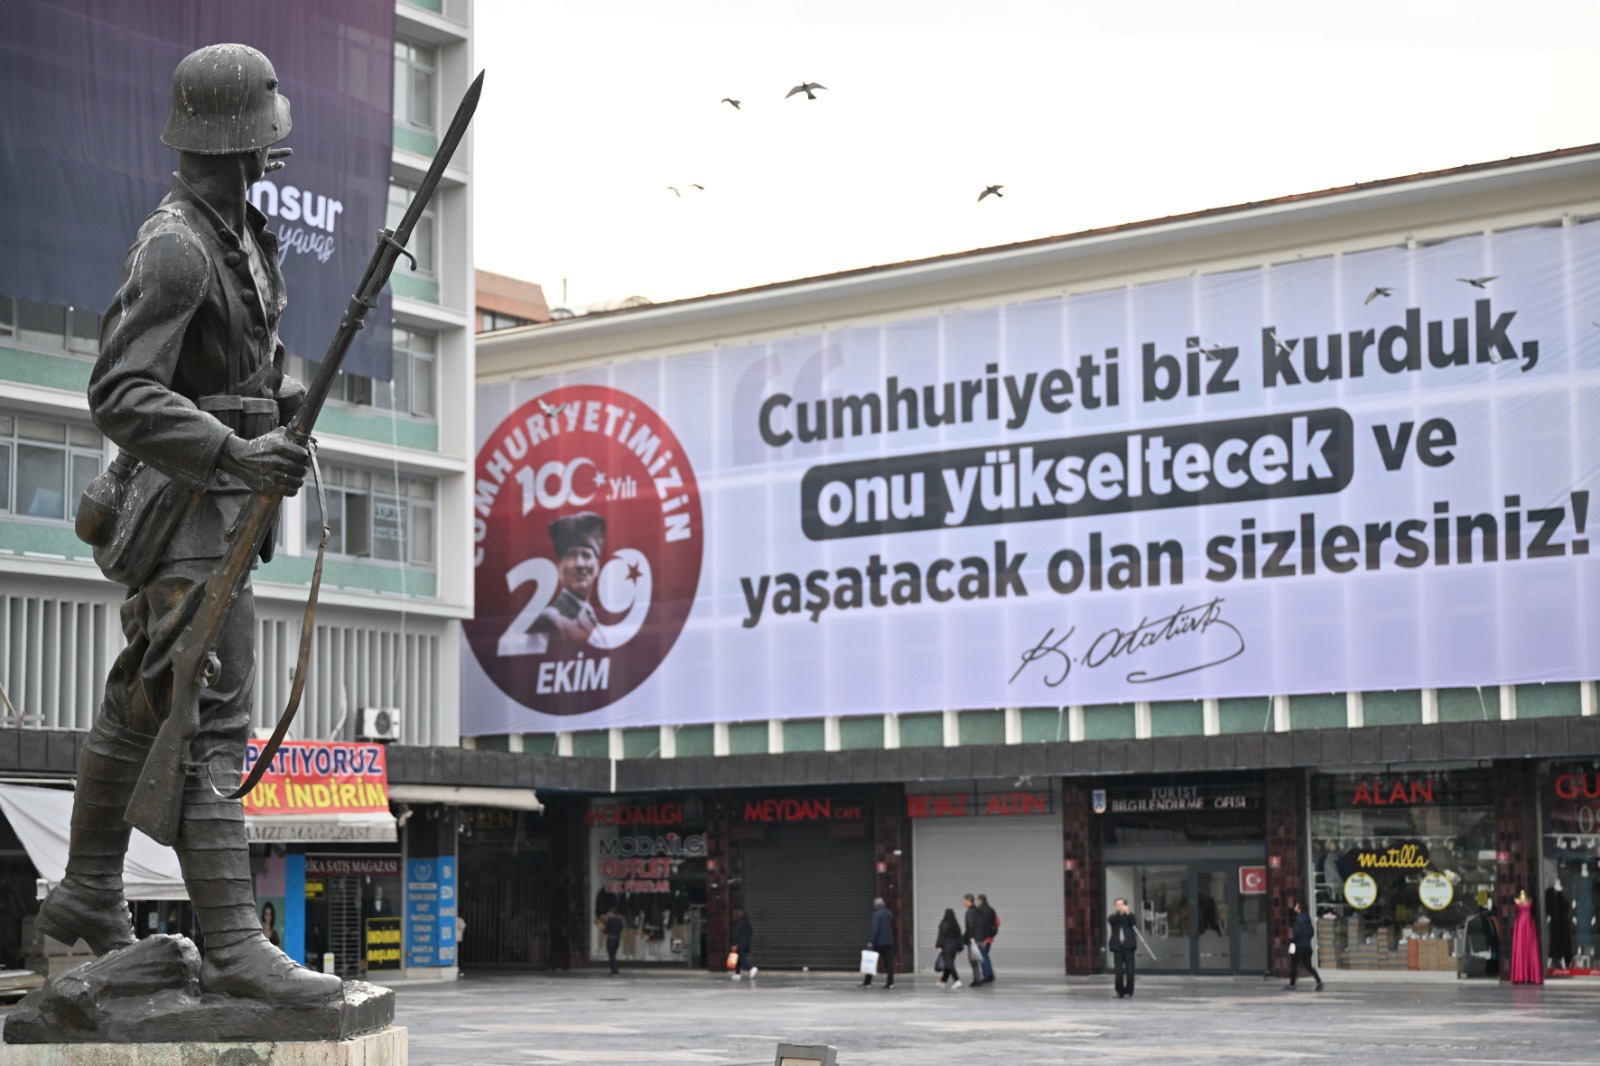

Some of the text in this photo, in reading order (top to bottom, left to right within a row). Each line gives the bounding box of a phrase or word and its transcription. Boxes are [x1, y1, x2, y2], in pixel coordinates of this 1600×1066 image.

[246, 180, 343, 233] nsur
[758, 297, 1540, 448] Cumhuriyeti biz kurduk,
[817, 415, 1457, 527] onu yükseltecek ve
[740, 489, 1591, 629] yaşatacak olan sizlersiniz!
[536, 651, 610, 694] EKİM
[284, 776, 389, 809] İNDİRİM
[743, 799, 832, 822] MEYDAN
[985, 790, 1046, 816] ALTIN
[1353, 779, 1434, 805] ALAN
[602, 857, 671, 878] OUTLET
